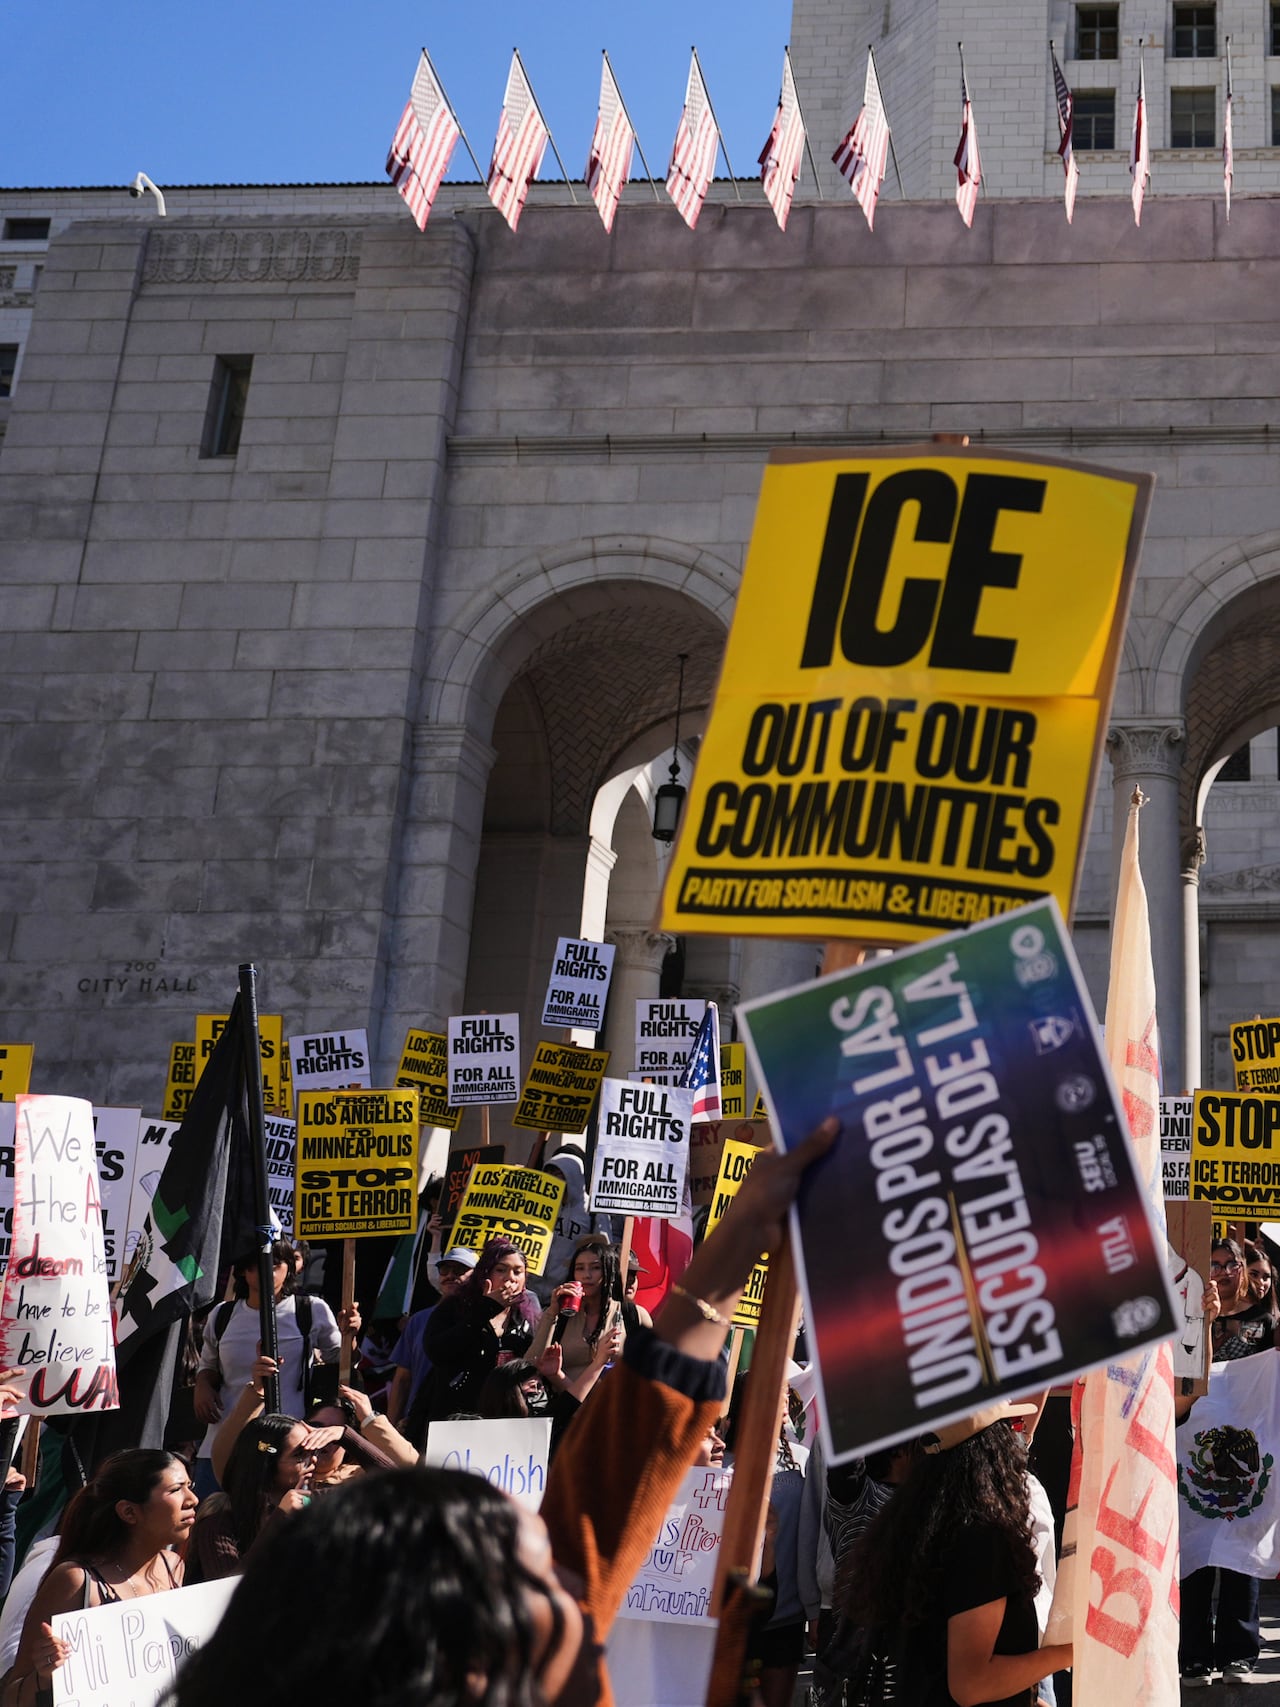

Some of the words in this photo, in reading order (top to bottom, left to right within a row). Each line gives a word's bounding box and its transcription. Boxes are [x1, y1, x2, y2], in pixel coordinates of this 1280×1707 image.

[800, 468, 1048, 674] ICE
[741, 697, 843, 777] OUT
[840, 697, 917, 773] OF
[915, 701, 1037, 788] OUR
[695, 780, 1061, 878] COMMUNITIES
[684, 876, 749, 907] PARTY
[748, 879, 783, 908] FOR
[784, 879, 888, 912] SOCIALISM
[886, 884, 914, 914] &
[564, 943, 601, 964] FULL
[124, 961, 157, 972] 200
[555, 959, 608, 981] RIGHTS
[78, 978, 128, 993] CITY
[140, 977, 198, 992] HALL
[550, 989, 575, 1005] FOR
[577, 992, 600, 1008] ALL
[547, 1004, 599, 1019] IMMIGRANTS
[649, 1004, 690, 1021] FULL
[461, 1019, 505, 1037] FULL
[640, 1021, 699, 1038] RIGHTS
[303, 1036, 353, 1057] FULL
[453, 1035, 515, 1054] RIGHTS
[830, 984, 914, 1096] LAS
[296, 1051, 364, 1075] RIGHTS
[536, 1048, 557, 1065] LOS
[558, 1052, 604, 1072] ANGELES
[454, 1068, 483, 1082] FOR
[487, 1066, 514, 1080] ALL
[530, 1068, 598, 1091] MINNEAPOLIS
[924, 1038, 1000, 1120] DE
[1237, 1069, 1250, 1086] ICE
[452, 1082, 516, 1094] IMMIGRANTS
[520, 1087, 591, 1107] STOP
[335, 1096, 385, 1105] FROM
[619, 1088, 673, 1118] FULL
[303, 1103, 337, 1125] LOS
[340, 1101, 413, 1125] ANGELES
[518, 1102, 542, 1120] ICE
[543, 1104, 586, 1125] TERROR
[23, 1109, 82, 1165] We
[347, 1129, 371, 1138] TO
[606, 1112, 684, 1143] RIGHTS
[302, 1134, 413, 1160] MINNEAPOLIS
[862, 1095, 942, 1203] POR
[301, 1168, 413, 1190] STOP
[602, 1157, 638, 1180] FOR
[643, 1162, 678, 1184] ALL
[1194, 1160, 1219, 1183] ICE
[474, 1170, 501, 1186] LOS
[501, 1174, 560, 1200] ANGELES
[598, 1179, 677, 1199] IMMIGRANTS
[20, 1173, 77, 1226] the
[301, 1192, 333, 1218] ICE
[338, 1189, 412, 1217] TERROR
[466, 1192, 553, 1220] MINNEAPOLIS
[1219, 1206, 1245, 1216] SOCIALISM
[1245, 1207, 1252, 1216] &
[302, 1223, 321, 1233] PARTY
[322, 1222, 334, 1232] FOR
[334, 1220, 367, 1231] SOCIALISM
[368, 1221, 376, 1230] &
[376, 1219, 410, 1229] LIBERATION
[459, 1214, 548, 1237] STOP
[452, 1229, 477, 1247] ICE
[946, 1114, 1064, 1376] ESCUELAS
[1097, 1215, 1134, 1275] UTLA
[17, 1232, 84, 1278] dream
[16, 1285, 52, 1321] have
[60, 1292, 76, 1318] to
[882, 1199, 985, 1408] UNIDOS
[17, 1328, 95, 1366] believe
[60, 1616, 110, 1696] Mi
